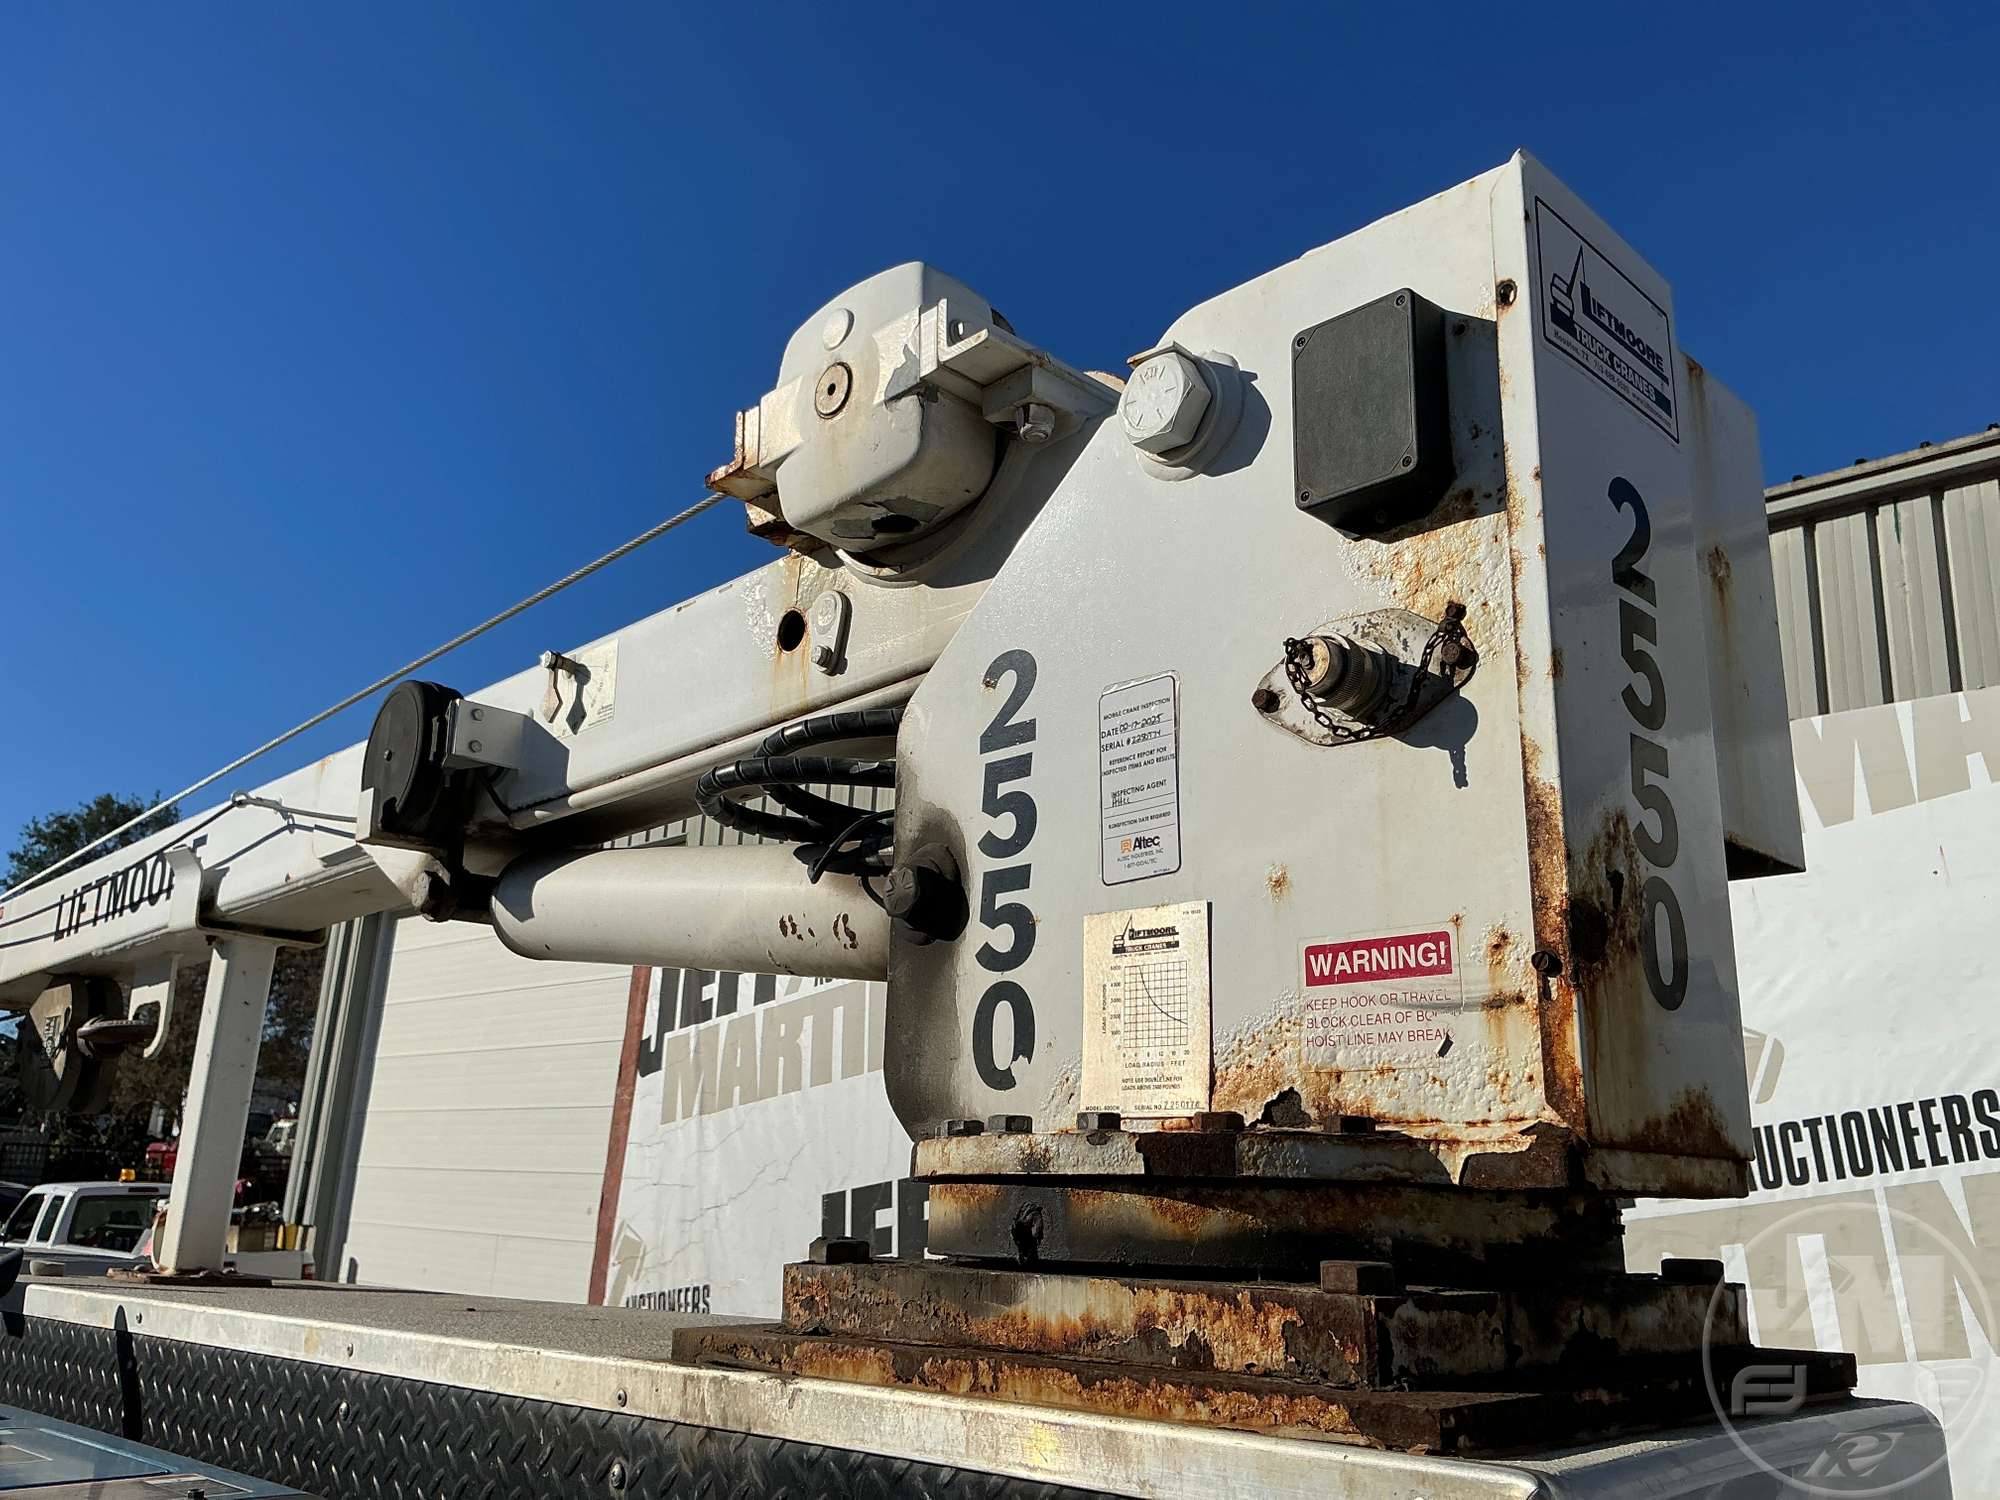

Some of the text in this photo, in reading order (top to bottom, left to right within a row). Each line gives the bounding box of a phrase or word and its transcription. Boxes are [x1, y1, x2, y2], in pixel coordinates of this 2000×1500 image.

[1580, 281, 1665, 373] LIFTMOORE
[1573, 322, 1612, 366] TRUCK
[1613, 356, 1656, 402] CRANES
[1104, 698, 1170, 720] MOBILE CRANE INSPECTION
[1101, 727, 1118, 739] DATE
[1101, 739, 1124, 752] SERIAL
[1607, 476, 1688, 1012] 2550
[1109, 754, 1135, 766] REFERENCE
[1137, 749, 1155, 759] REPORT
[1143, 758, 1155, 767] AND
[1111, 779, 1167, 799] INSPECTING AGENT
[1132, 835, 1160, 851] Altec
[973, 648, 1037, 1091] 2550
[1143, 942, 1167, 951] CRANES
[1309, 941, 1447, 977] WARNING!
[1305, 997, 1337, 1012] KEEP
[1341, 994, 1376, 1009] HOOK
[1380, 993, 1398, 1006] OR
[1306, 1015, 1347, 1029] BLOCK
[1351, 1012, 1391, 1027] CLEAR
[1395, 1011, 1412, 1024] OF
[1306, 1034, 1344, 1048] HOIST
[1347, 1032, 1374, 1046] LINE
[1378, 1030, 1404, 1044] MAY
[1749, 1089, 2000, 1191] UCTIONEERS
